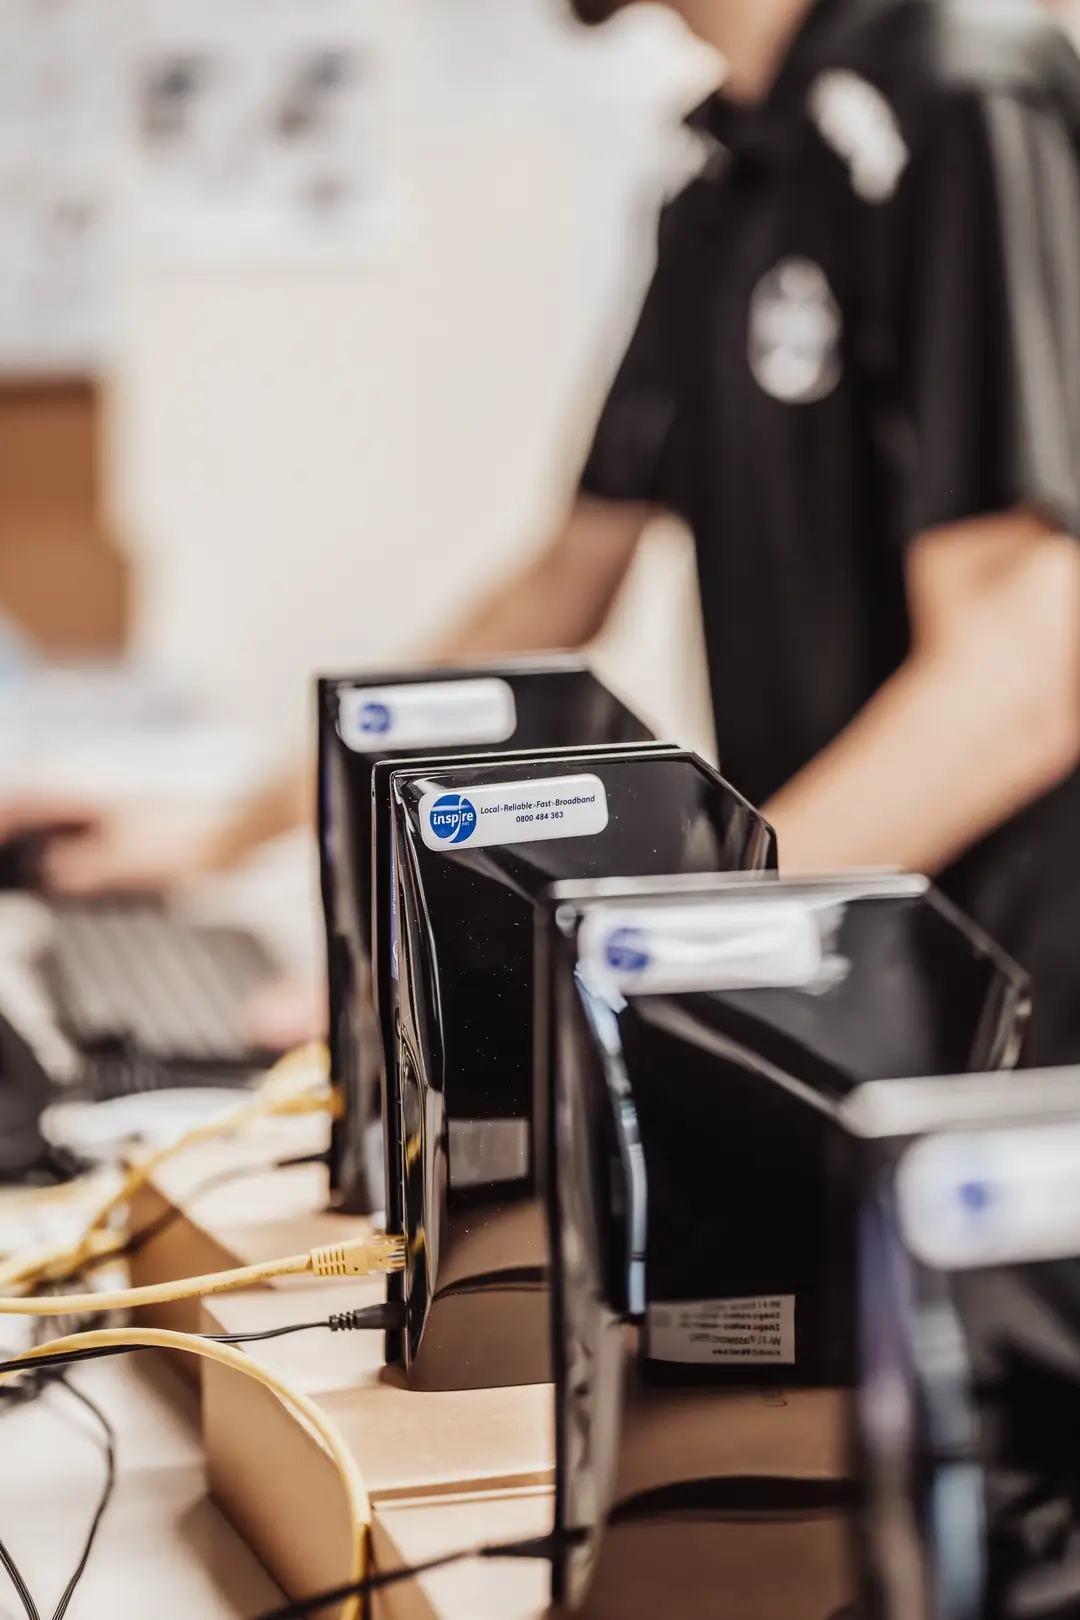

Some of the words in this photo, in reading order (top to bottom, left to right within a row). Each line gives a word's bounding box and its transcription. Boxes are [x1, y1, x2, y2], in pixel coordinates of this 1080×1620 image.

[480, 805, 500, 814] Local
[503, 802, 533, 812] Reliable
[536, 800, 552, 808] Fast
[555, 795, 595, 806] Broadband
[433, 810, 474, 828] inspire
[515, 814, 534, 823] 0800
[535, 813, 549, 821] 484
[550, 811, 564, 820] 363
